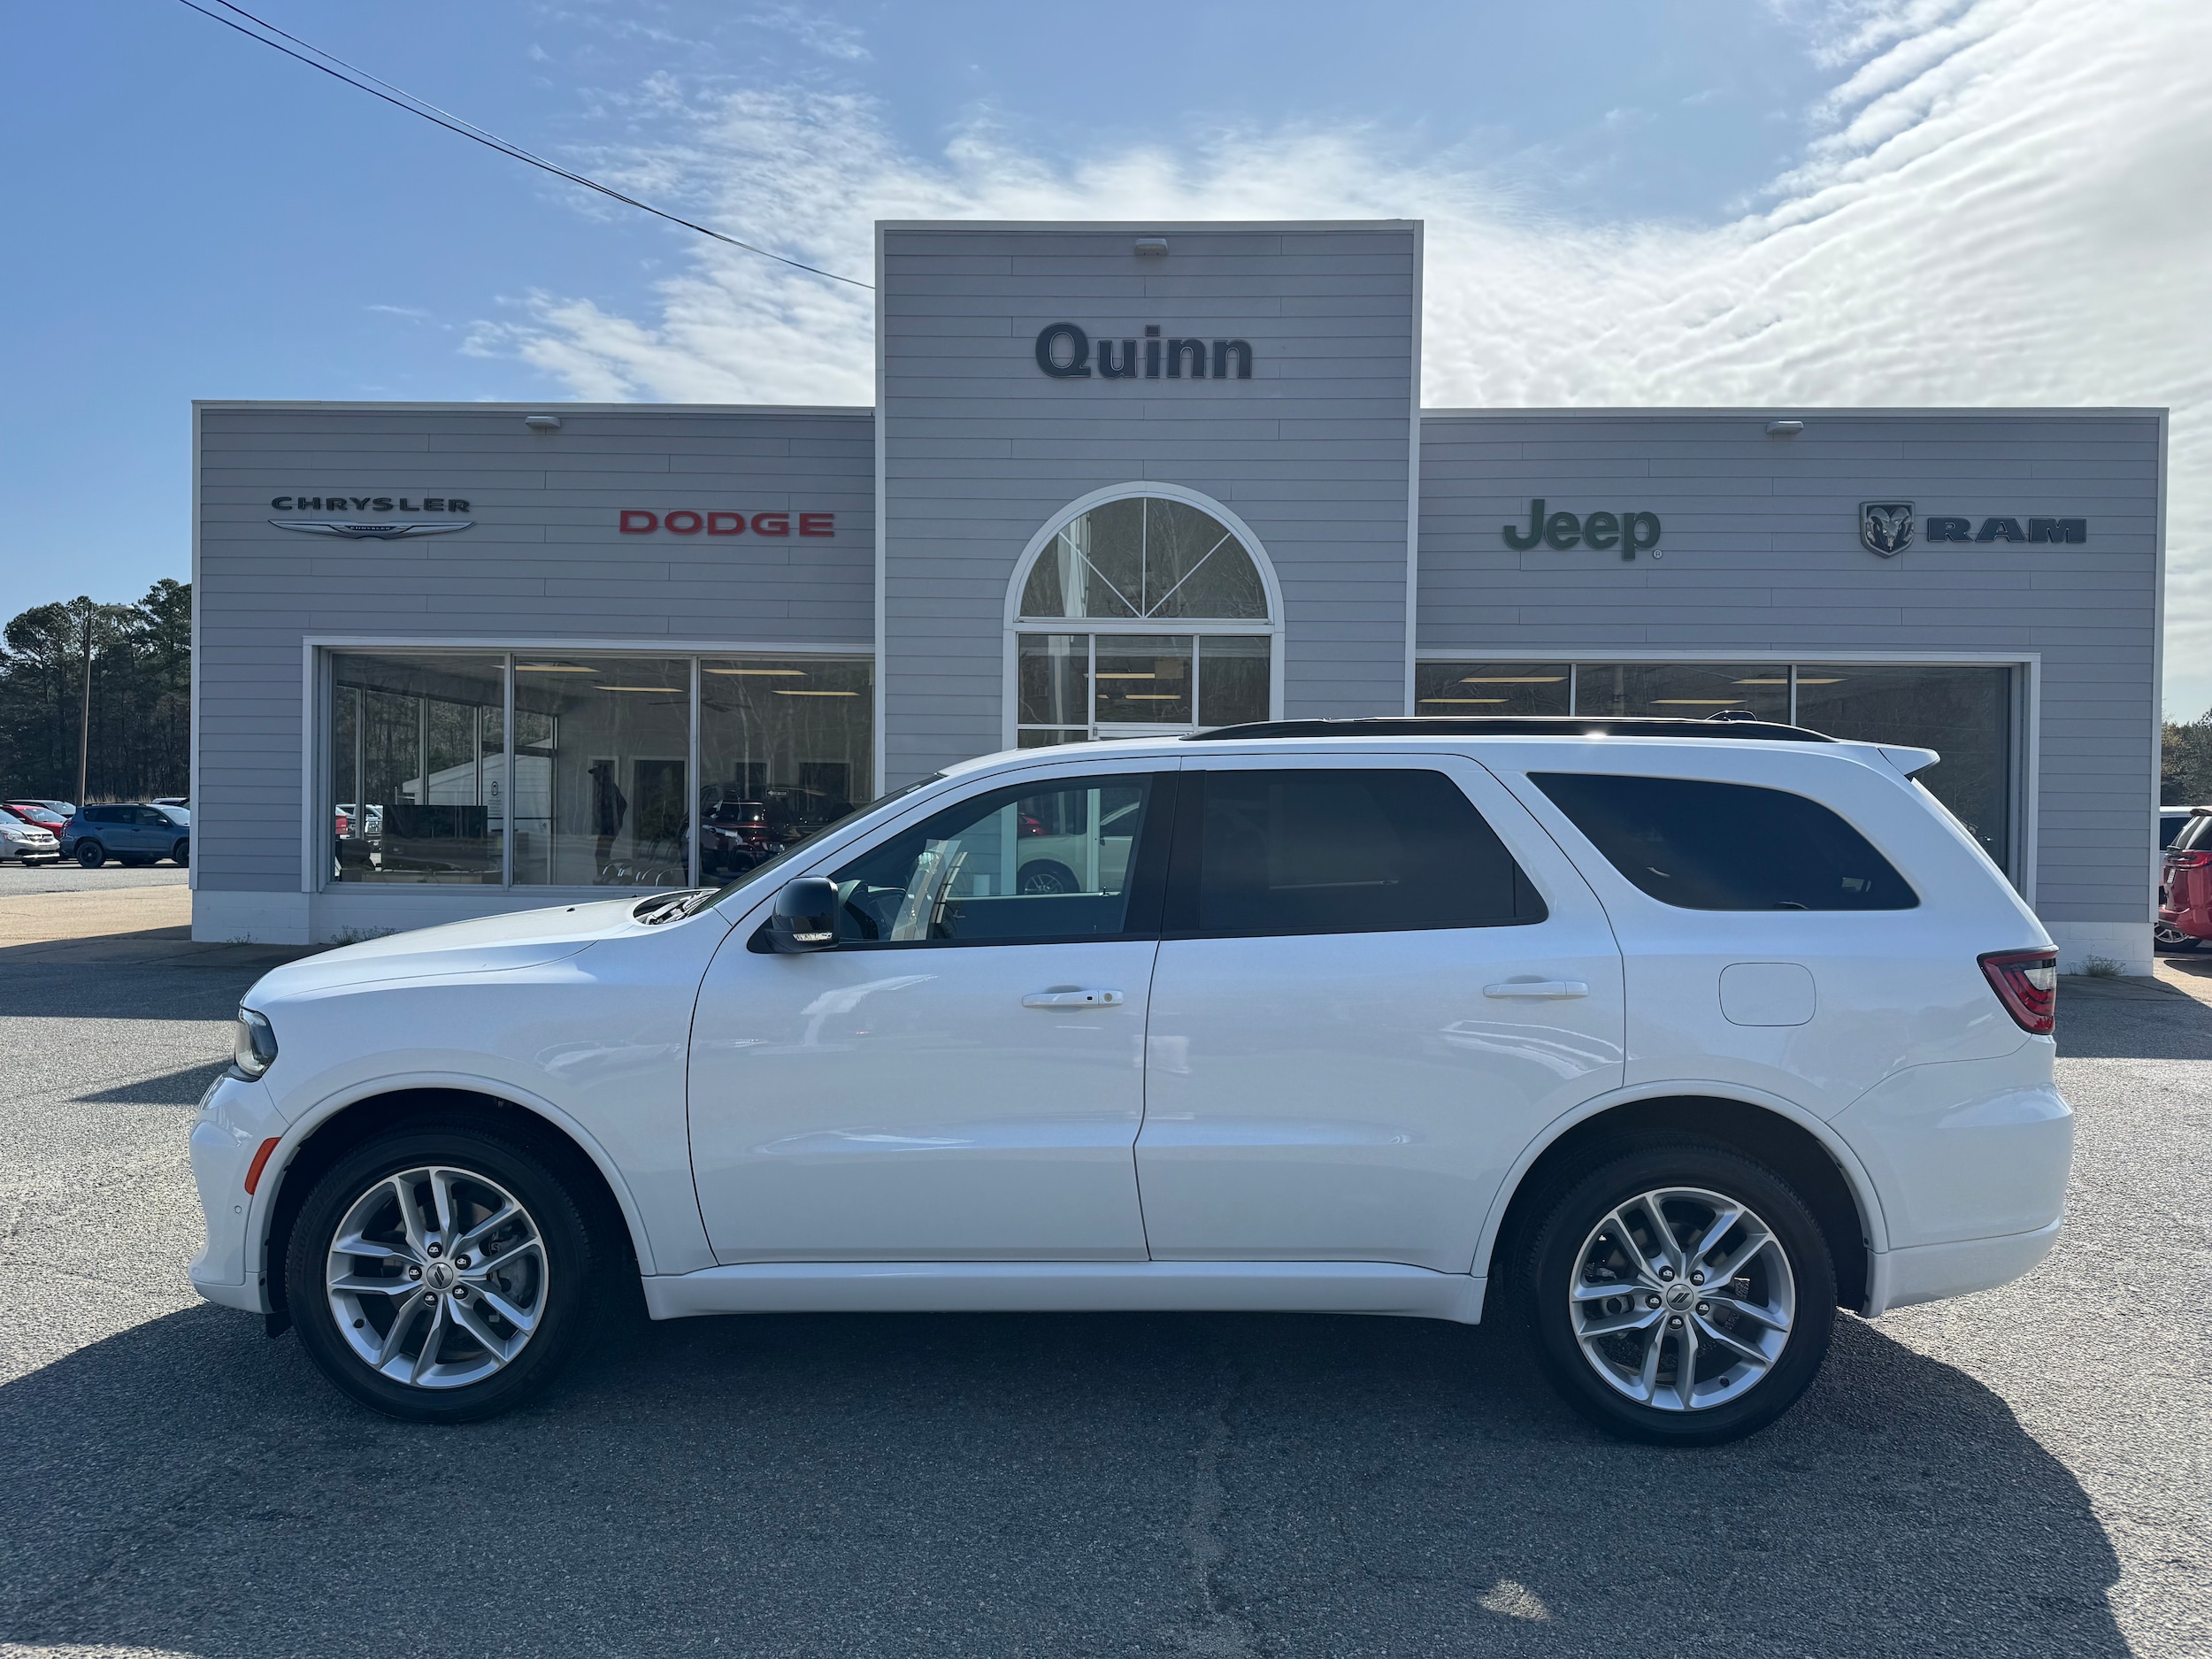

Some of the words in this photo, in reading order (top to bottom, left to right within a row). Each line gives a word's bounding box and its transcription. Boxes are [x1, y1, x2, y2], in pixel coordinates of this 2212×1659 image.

[1035, 322, 1252, 379] Quinn
[271, 495, 471, 512] CHRYSLER
[619, 510, 834, 537] DODGE
[1503, 498, 1661, 561] Jeep
[1927, 518, 2087, 543] RAM
